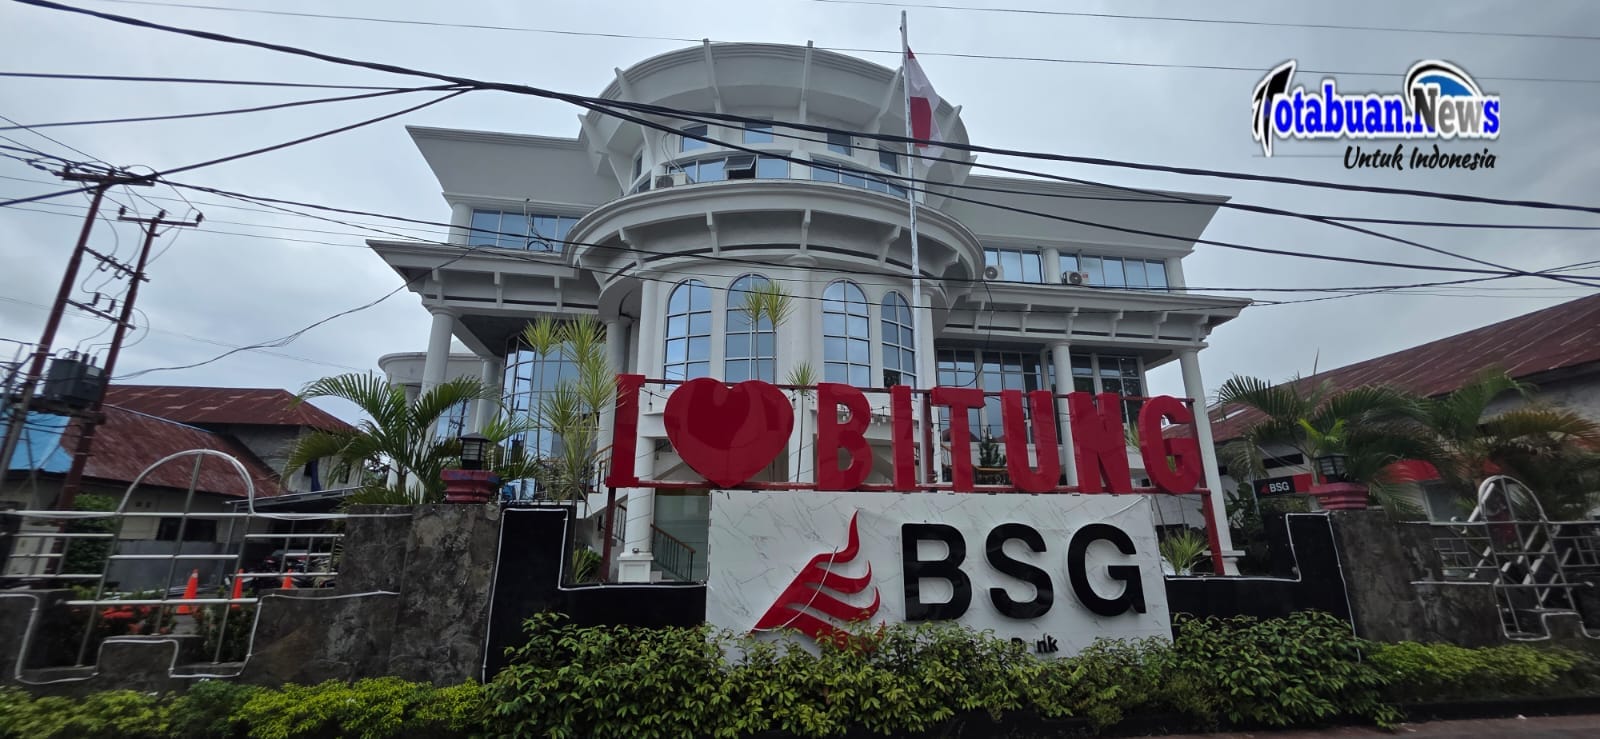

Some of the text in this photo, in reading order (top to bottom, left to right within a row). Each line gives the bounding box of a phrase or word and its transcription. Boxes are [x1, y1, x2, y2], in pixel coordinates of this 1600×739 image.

[606, 374, 1203, 494] I BITUNG
[1268, 481, 1290, 493] BSG
[901, 522, 1147, 621] BSG
